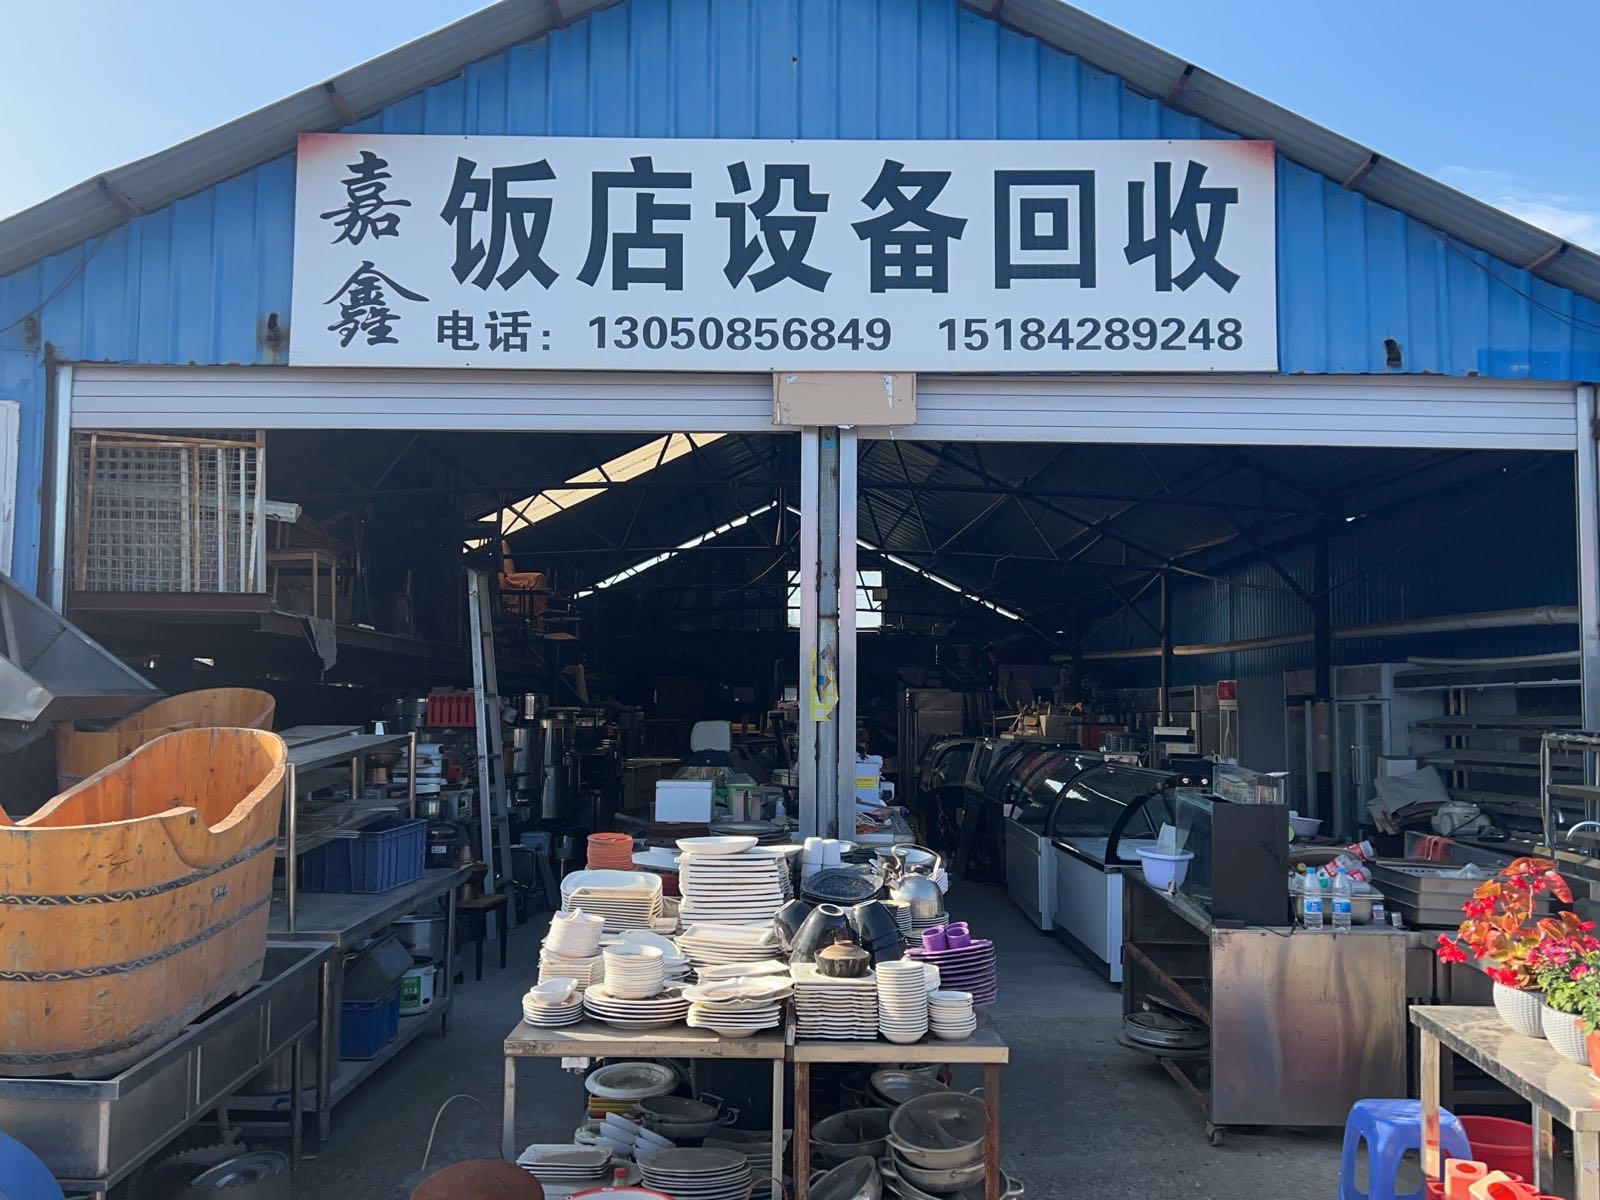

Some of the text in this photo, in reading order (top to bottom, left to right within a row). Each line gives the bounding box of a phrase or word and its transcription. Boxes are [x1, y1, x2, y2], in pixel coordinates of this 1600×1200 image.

[319, 150, 430, 348] 嘉鑫
[439, 155, 1242, 294] 饭店设备回收
[588, 315, 892, 351] 13050856849
[938, 317, 1244, 351] 15184289248
